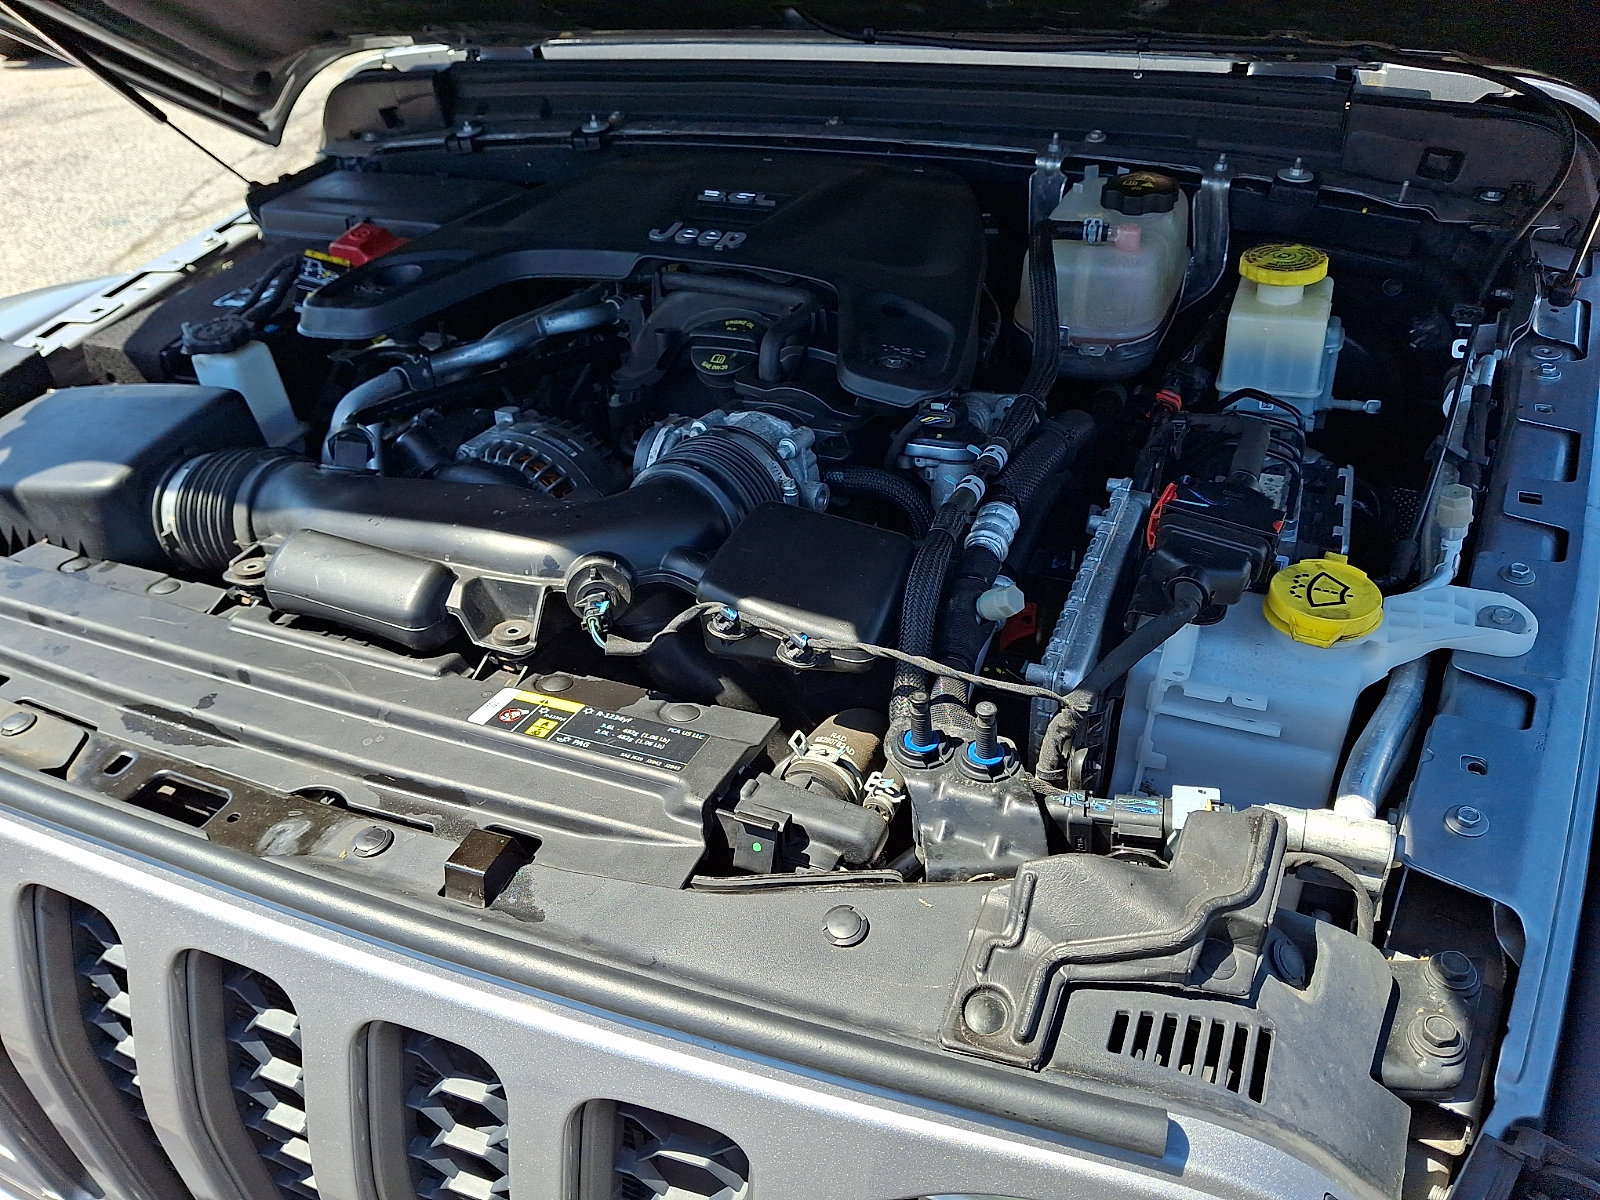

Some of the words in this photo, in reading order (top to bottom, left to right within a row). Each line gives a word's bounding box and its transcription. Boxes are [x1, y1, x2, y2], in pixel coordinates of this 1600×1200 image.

[649, 221, 747, 250] Jeep
[596, 710, 633, 723] R-1234yf
[830, 733, 846, 741] RAD
[572, 740, 591, 748] PAG
